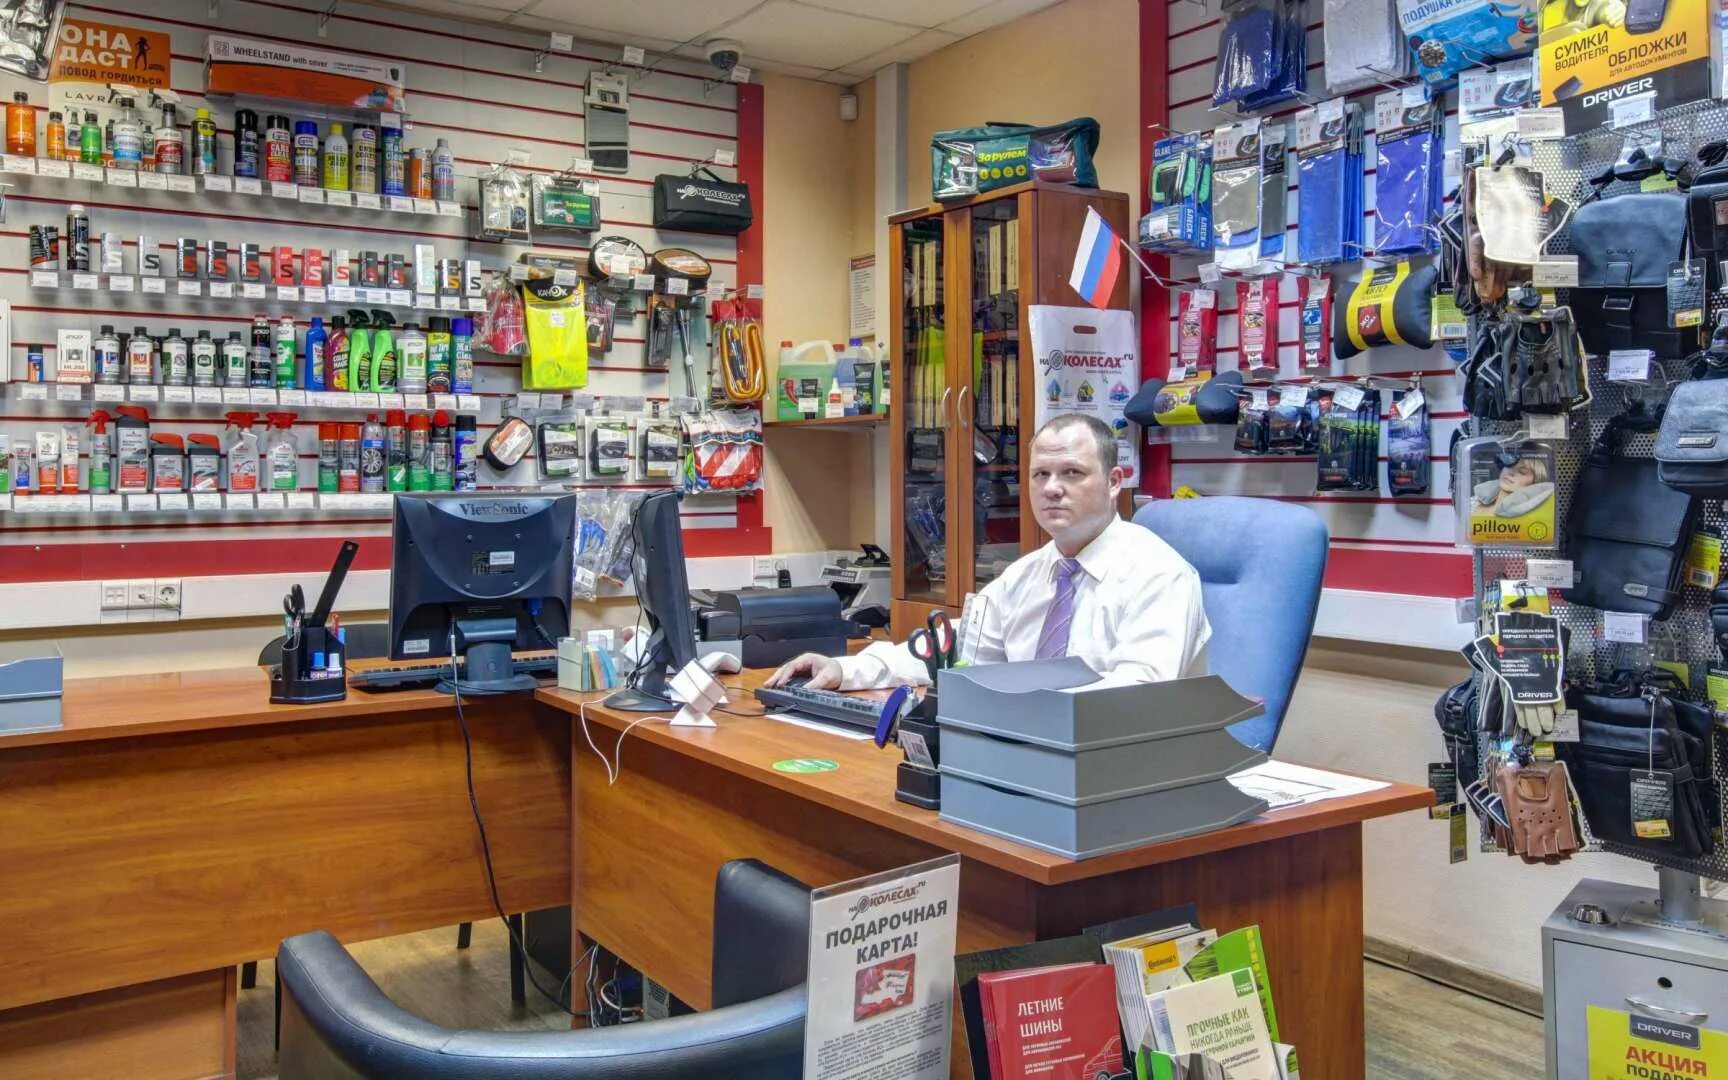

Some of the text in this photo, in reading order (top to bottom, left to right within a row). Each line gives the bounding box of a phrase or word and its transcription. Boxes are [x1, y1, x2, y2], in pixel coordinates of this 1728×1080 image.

[60, 24, 132, 52] ОНА
[1555, 30, 1609, 60] СУМКИ
[1608, 31, 1688, 68] ОБЛОЖКИ
[58, 45, 132, 69] ДАСТ
[233, 46, 290, 63] WHEELSTAND
[293, 57, 307, 65] with
[1555, 45, 1609, 71] ВОДИТЕЛЯ
[1624, 48, 1688, 73] АВТОДОКУМЕНТОВ
[59, 65, 163, 86] ПОВОД ГОРДИТЬСЯ
[1583, 77, 1654, 108] DRIVER
[459, 502, 529, 516] ViewSonic
[1473, 520, 1521, 536] pillow
[826, 899, 948, 950] ПОДАРОЧНАЯ
[856, 931, 920, 965] КАРТА!
[1018, 996, 1065, 1017] ЛЕТНИЕ
[1020, 1017, 1063, 1038] ШИНЫ
[1186, 1007, 1250, 1038] ПРОЧНЫЕ КАК
[1637, 1021, 1692, 1041] DRIVER
[1190, 1031, 1225, 1050] НИКОГДА
[1225, 1022, 1254, 1038] РАНЬШЕ
[1626, 1046, 1707, 1077] АКЦИЯ
